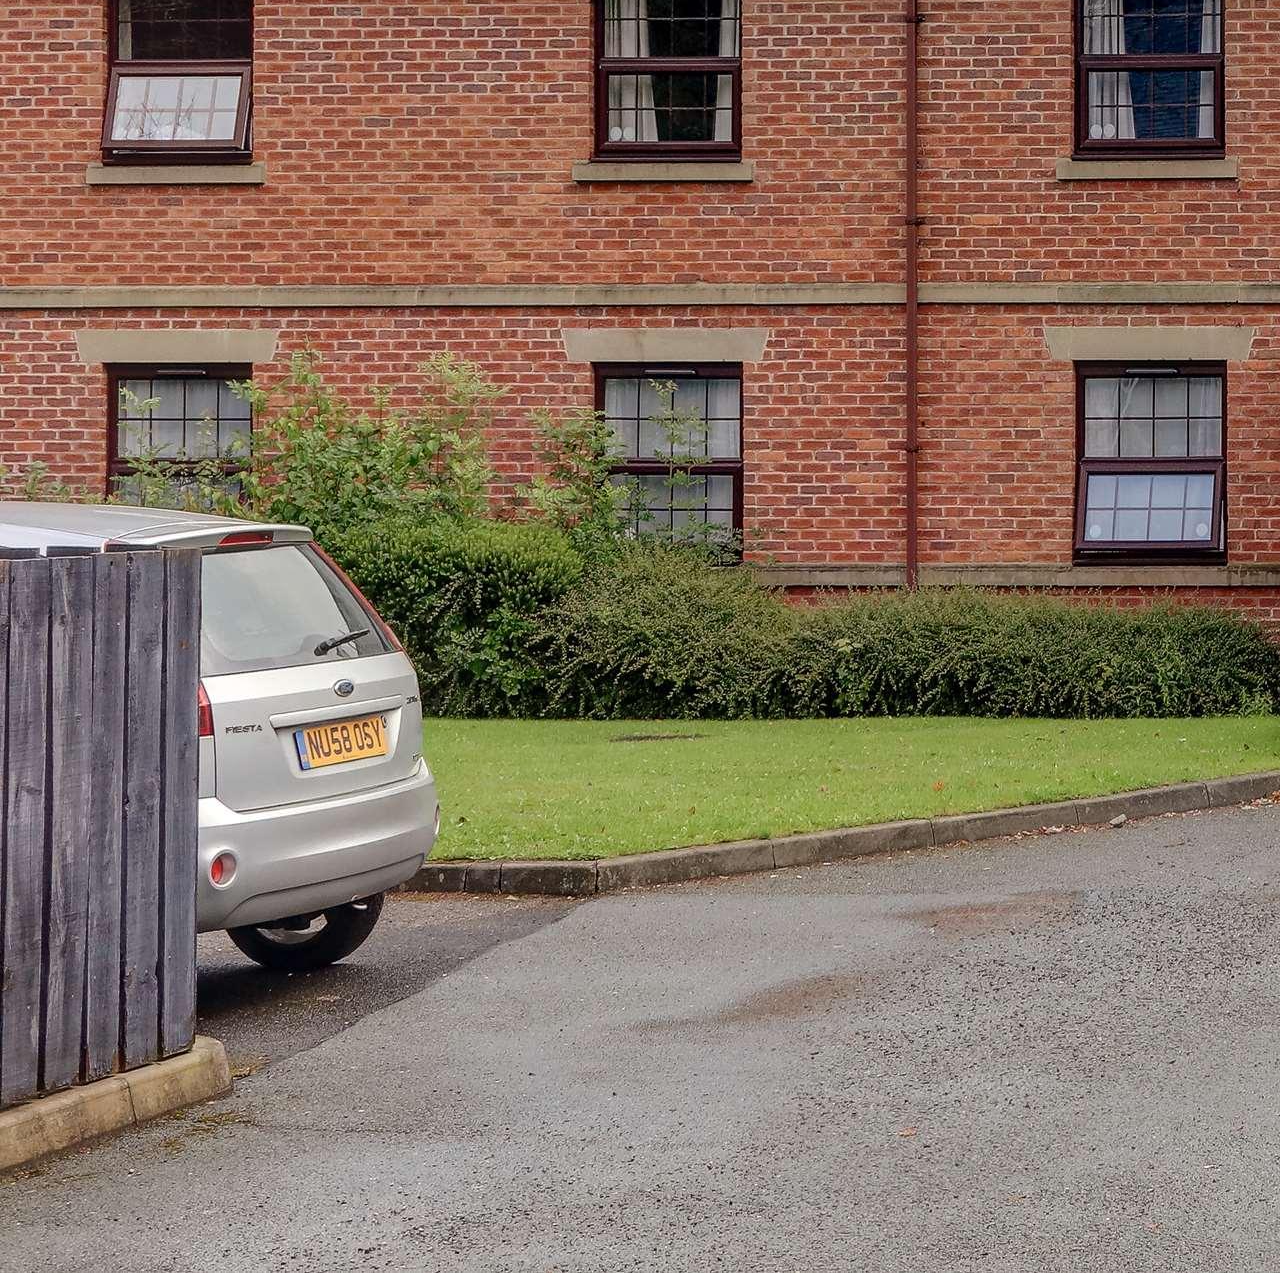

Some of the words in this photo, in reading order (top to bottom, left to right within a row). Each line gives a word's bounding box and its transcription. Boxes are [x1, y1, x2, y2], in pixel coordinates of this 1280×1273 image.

[225, 724, 263, 734] FIESTA
[306, 725, 353, 760] NU58
[355, 719, 382, 750] OSY
